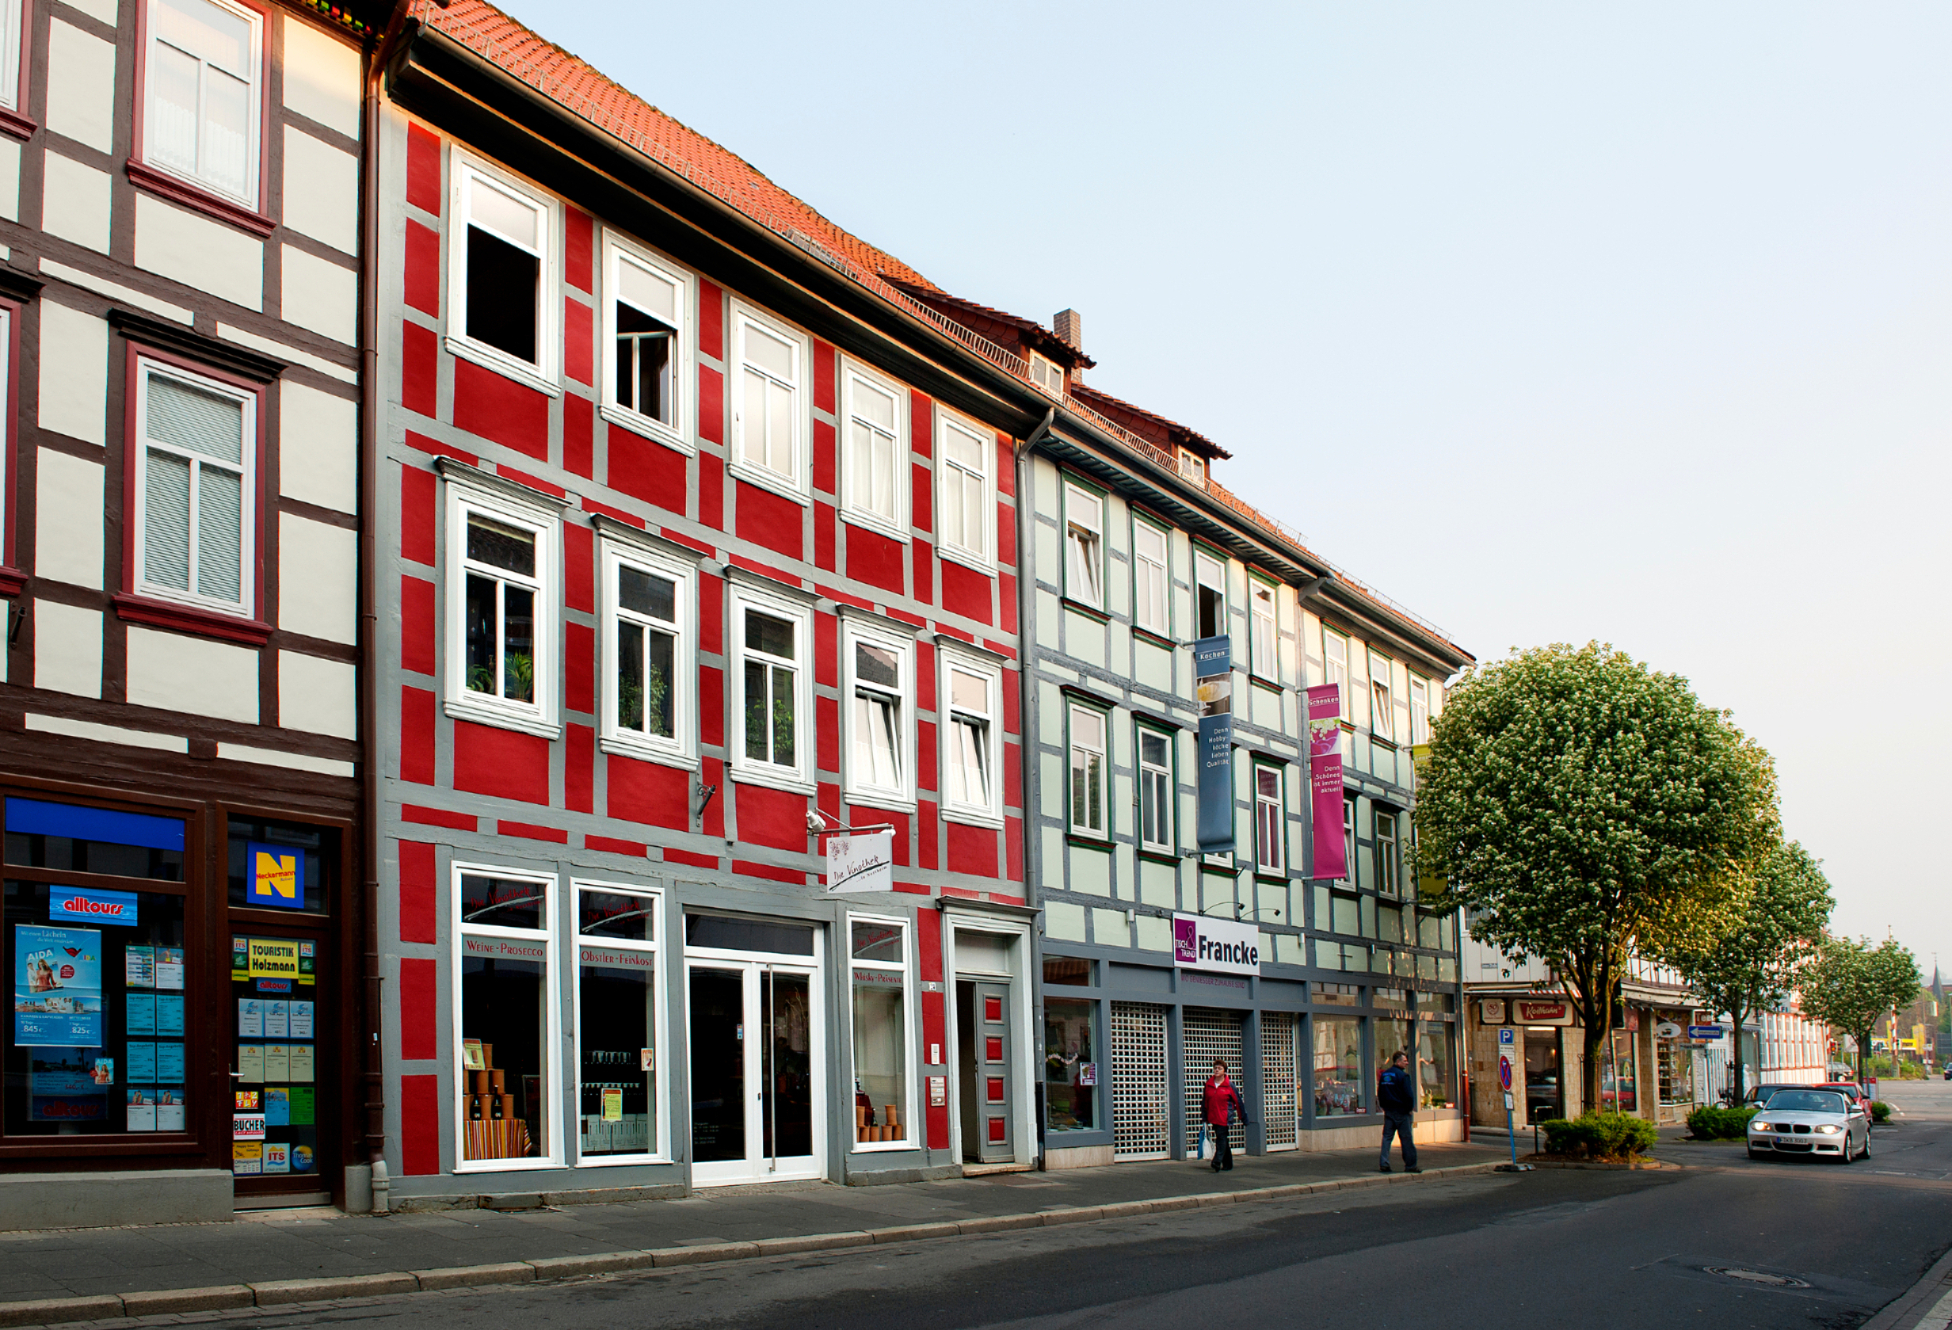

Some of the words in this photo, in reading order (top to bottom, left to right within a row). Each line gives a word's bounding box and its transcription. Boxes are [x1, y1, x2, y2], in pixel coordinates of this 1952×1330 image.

[1200, 651, 1225, 660] Kochen
[1308, 697, 1339, 705] Schenken
[832, 871, 844, 884] Die
[847, 855, 880, 875] Vinothek
[488, 886, 535, 905] Vinothek
[63, 896, 124, 915] alltours
[603, 900, 644, 918] Vinothek
[42, 930, 66, 938] Lächeln
[27, 949, 53, 961] AIDA
[252, 944, 294, 957] TOURISTIK
[1199, 935, 1258, 966] Francke
[252, 958, 295, 972] Holzmann
[259, 981, 288, 989] alltours
[23, 1025, 38, 1033] 845
[1502, 1031, 1510, 1042] P
[42, 1100, 100, 1117] alltours
[233, 1120, 265, 1131] BUCHER
[268, 1152, 285, 1161] ITS
